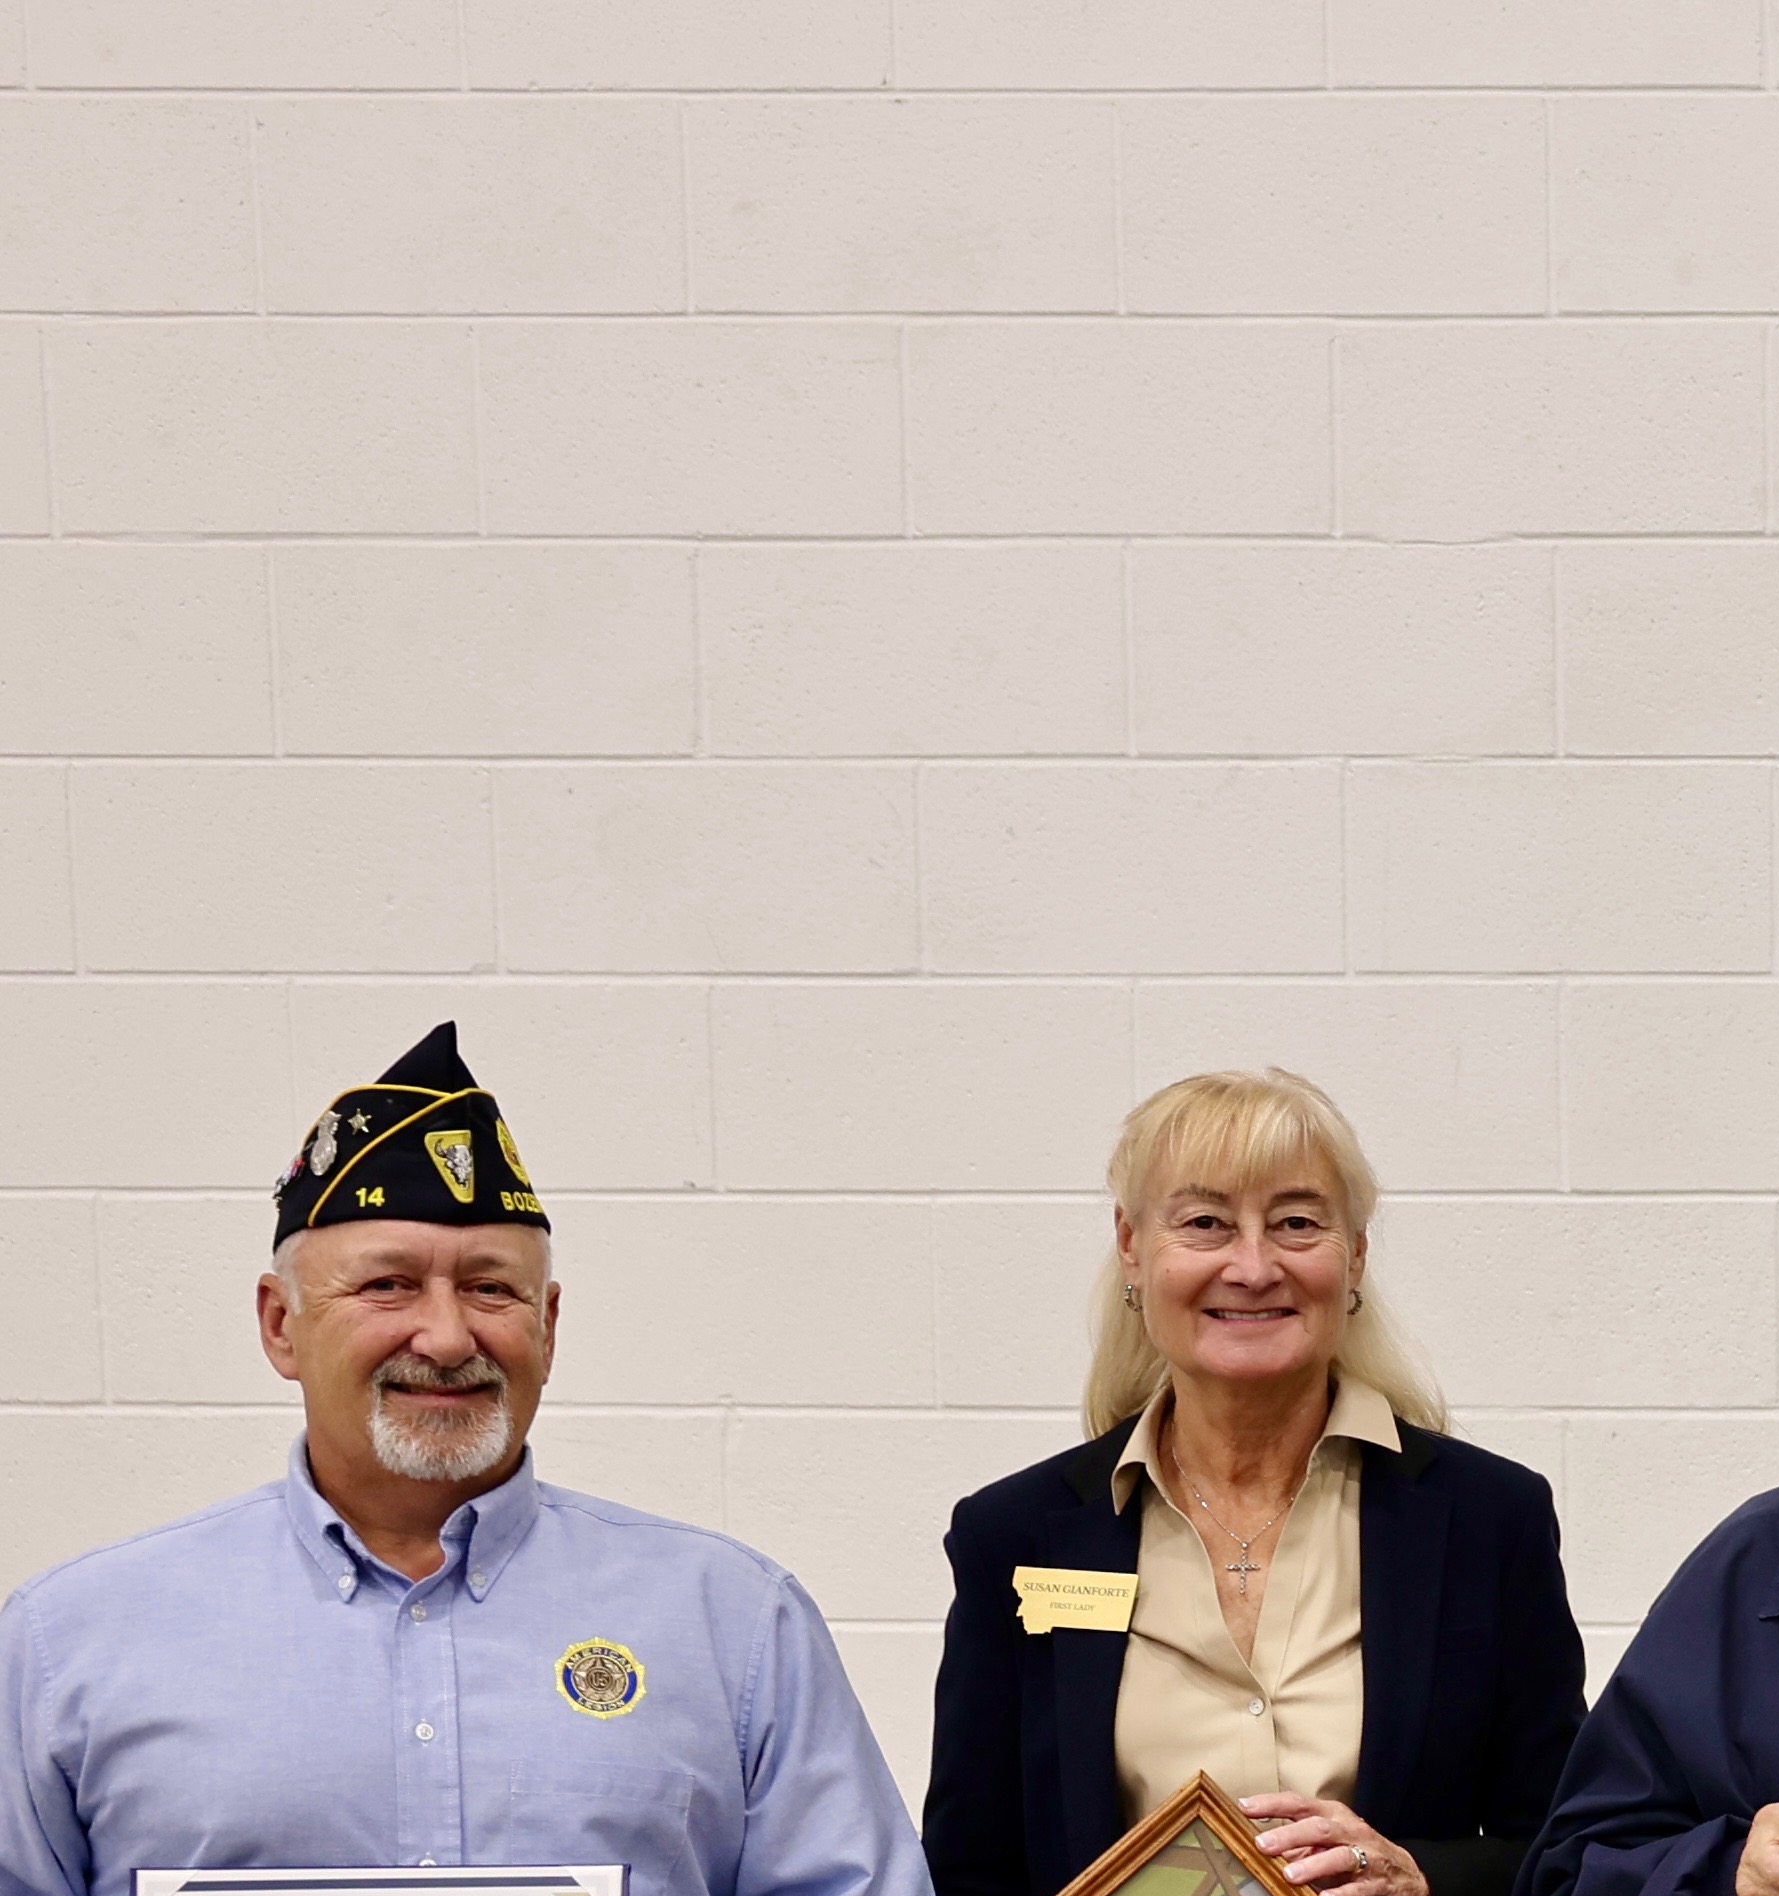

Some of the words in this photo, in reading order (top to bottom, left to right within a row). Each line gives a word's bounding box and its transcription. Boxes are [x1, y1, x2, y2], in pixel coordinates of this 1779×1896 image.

[356, 1186, 386, 1208] 14
[1023, 1582, 1062, 1594] SUSAN
[1062, 1585, 1131, 1599] GIANFORTE
[1049, 1601, 1073, 1611] FIRST
[1073, 1603, 1097, 1612] LADY
